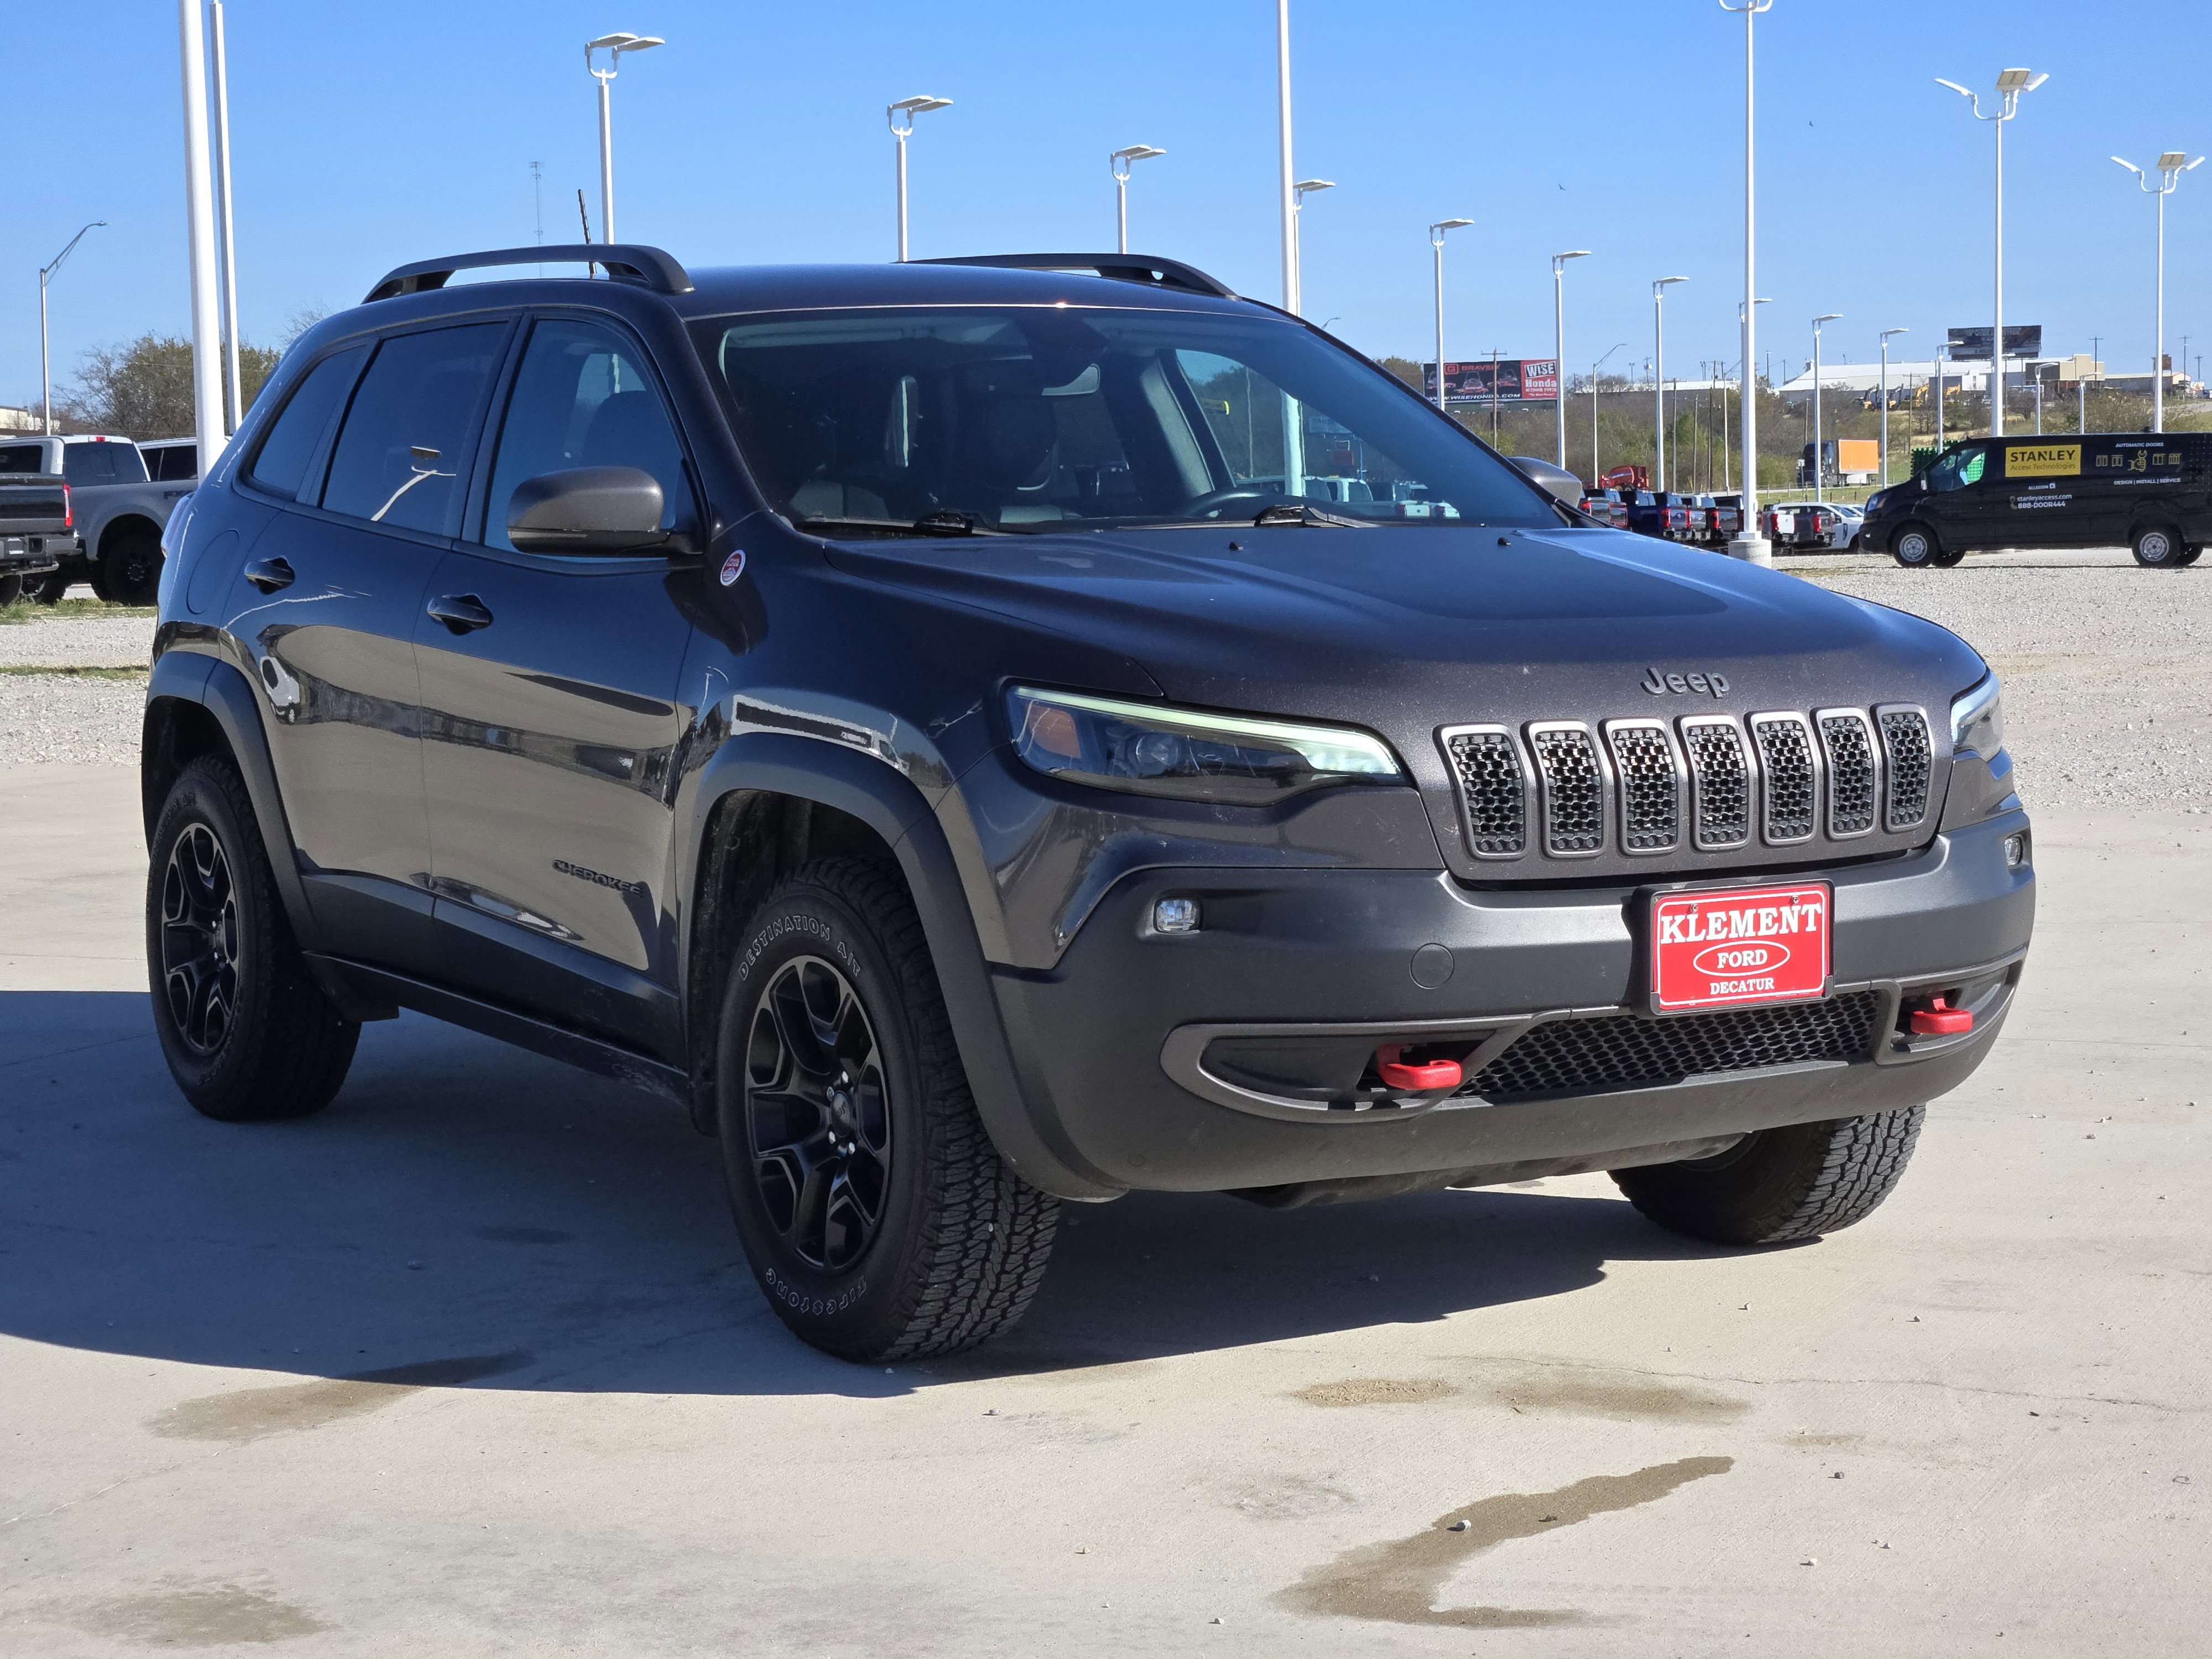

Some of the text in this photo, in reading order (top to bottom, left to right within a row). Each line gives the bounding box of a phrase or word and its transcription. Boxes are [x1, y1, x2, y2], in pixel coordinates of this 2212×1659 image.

[1526, 363, 1554, 377] WISE
[1525, 379, 1557, 388] Honda
[2010, 450, 2075, 463] STANLEY
[1640, 667, 1730, 699] Jeep
[552, 859, 645, 898] CHEROKEE
[1660, 903, 1822, 944] KLEMENT
[738, 915, 861, 981] DESTINATION A/T
[1717, 949, 1768, 969] FORD
[1710, 977, 1775, 995] DECATUR
